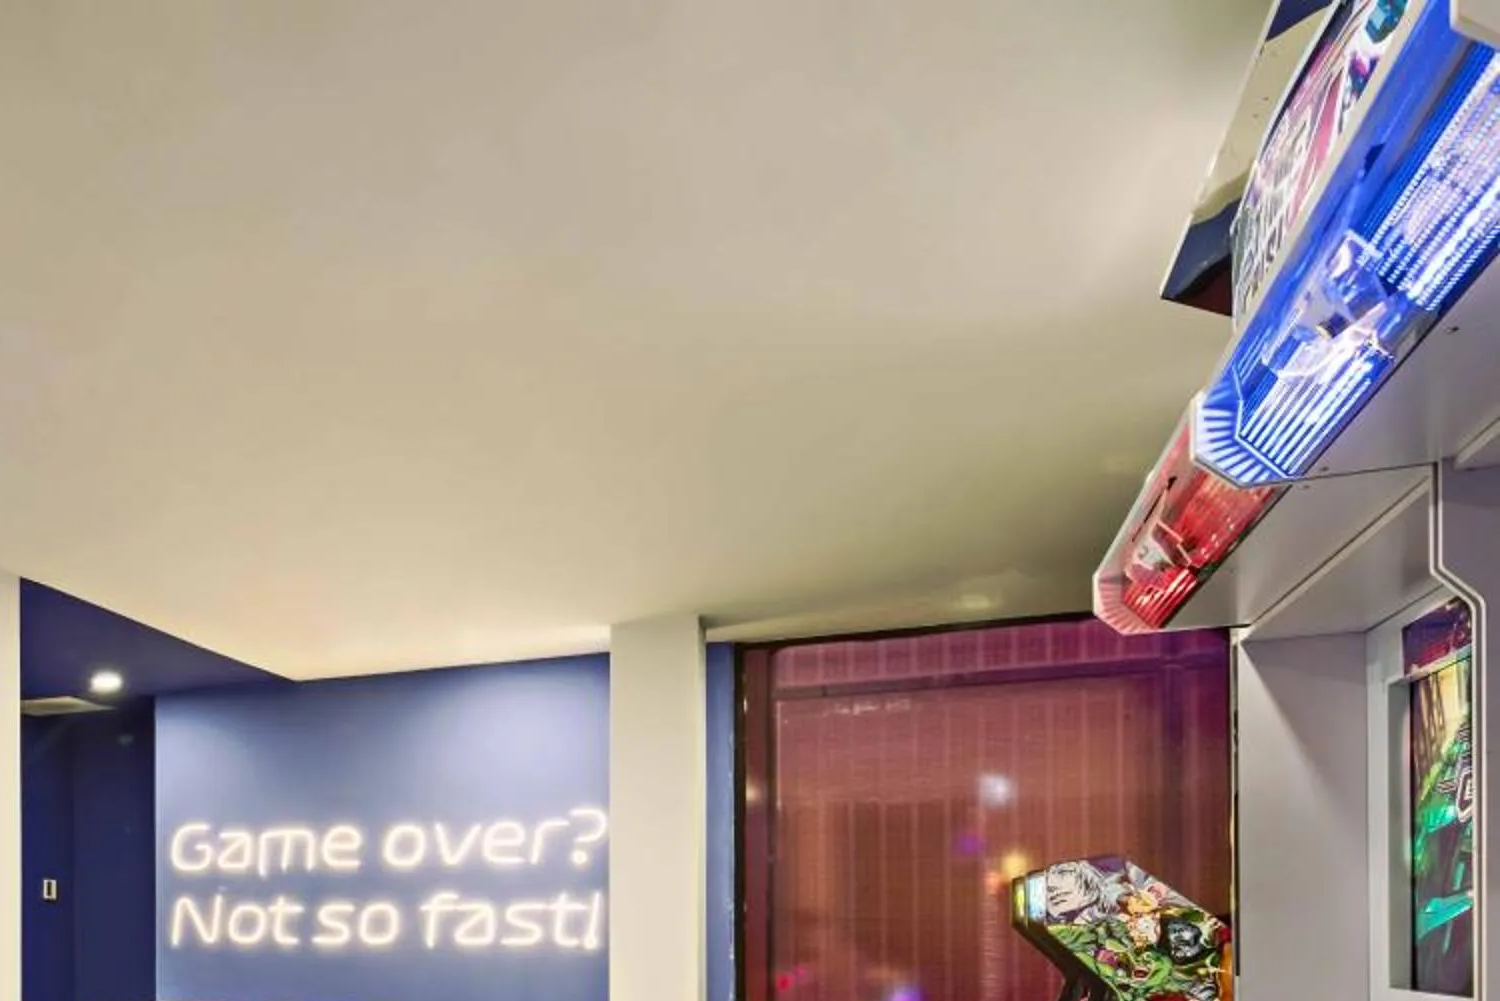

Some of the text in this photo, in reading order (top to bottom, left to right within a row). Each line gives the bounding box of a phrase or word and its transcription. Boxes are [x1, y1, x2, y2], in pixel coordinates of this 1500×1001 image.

[171, 808, 608, 877] Game over?
[171, 891, 604, 951] Not so fast!
